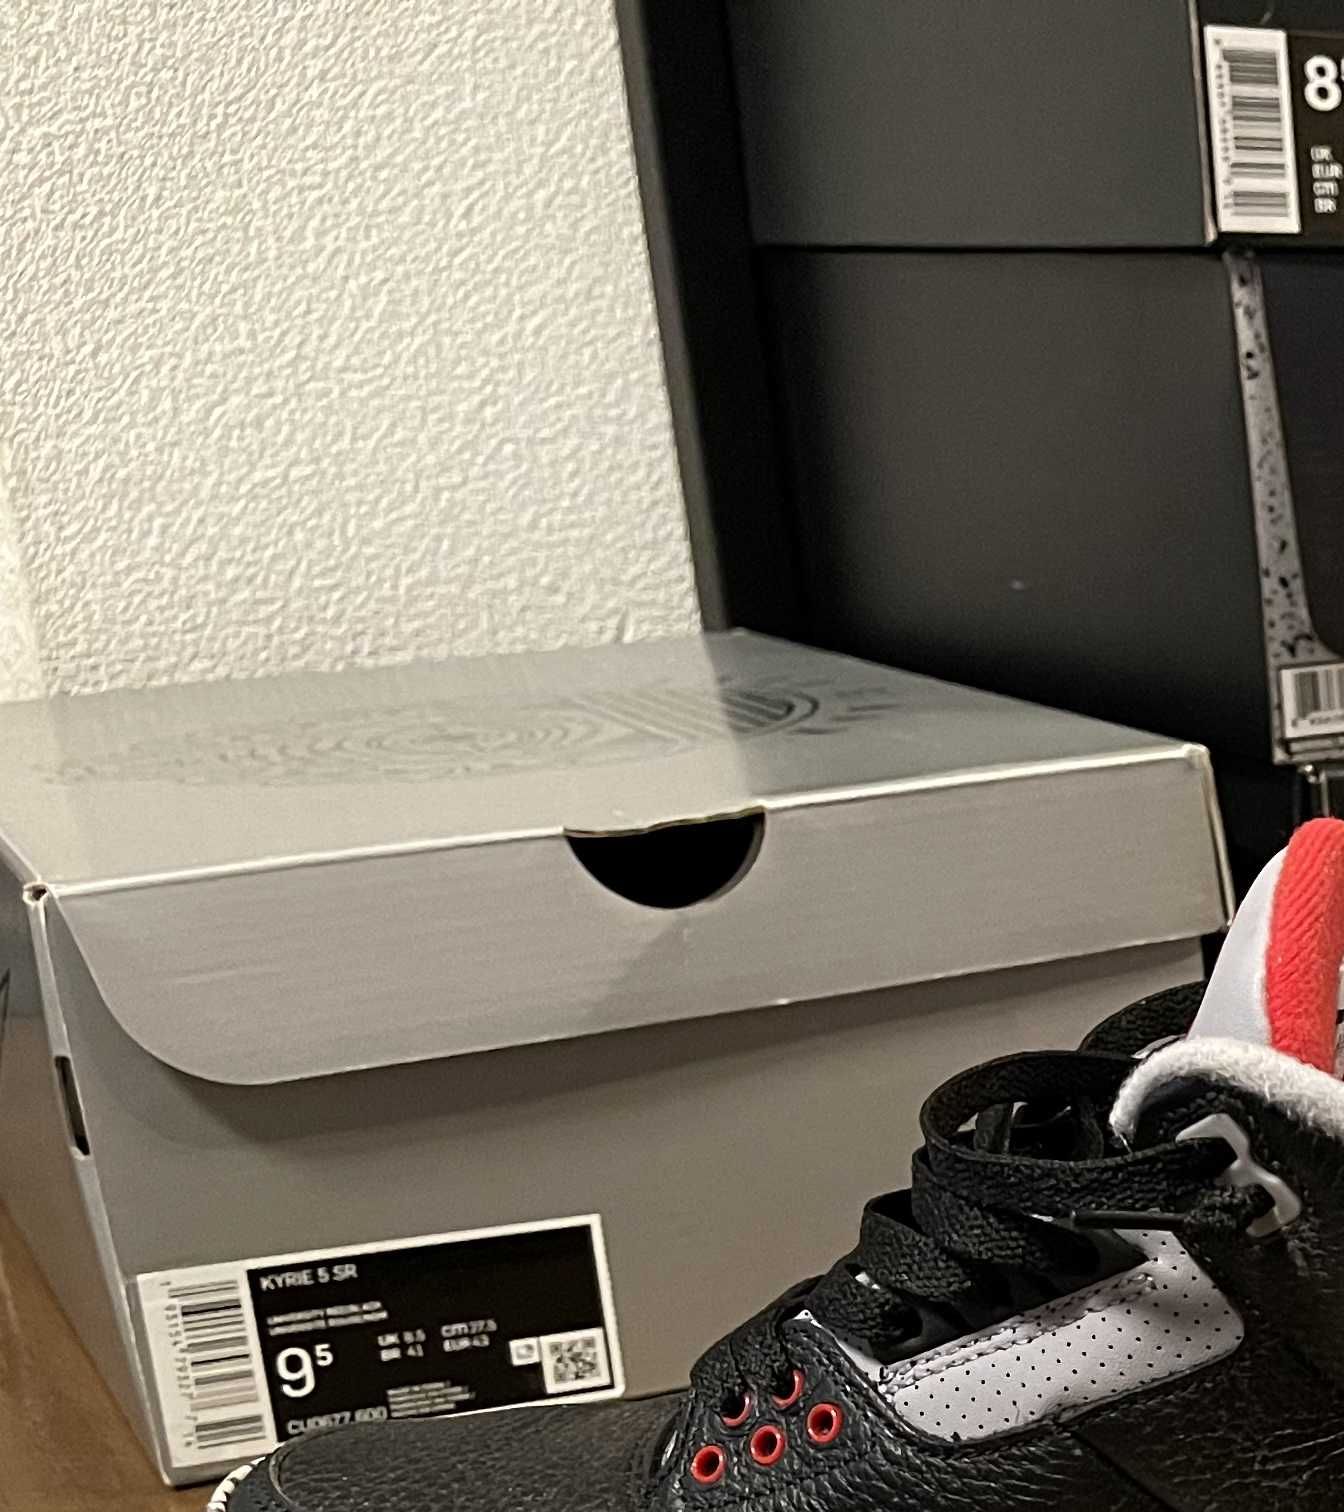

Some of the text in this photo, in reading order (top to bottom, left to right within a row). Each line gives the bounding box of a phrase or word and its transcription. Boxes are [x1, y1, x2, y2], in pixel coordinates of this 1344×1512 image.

[260, 1262, 358, 1292] KYRIE 5 SR
